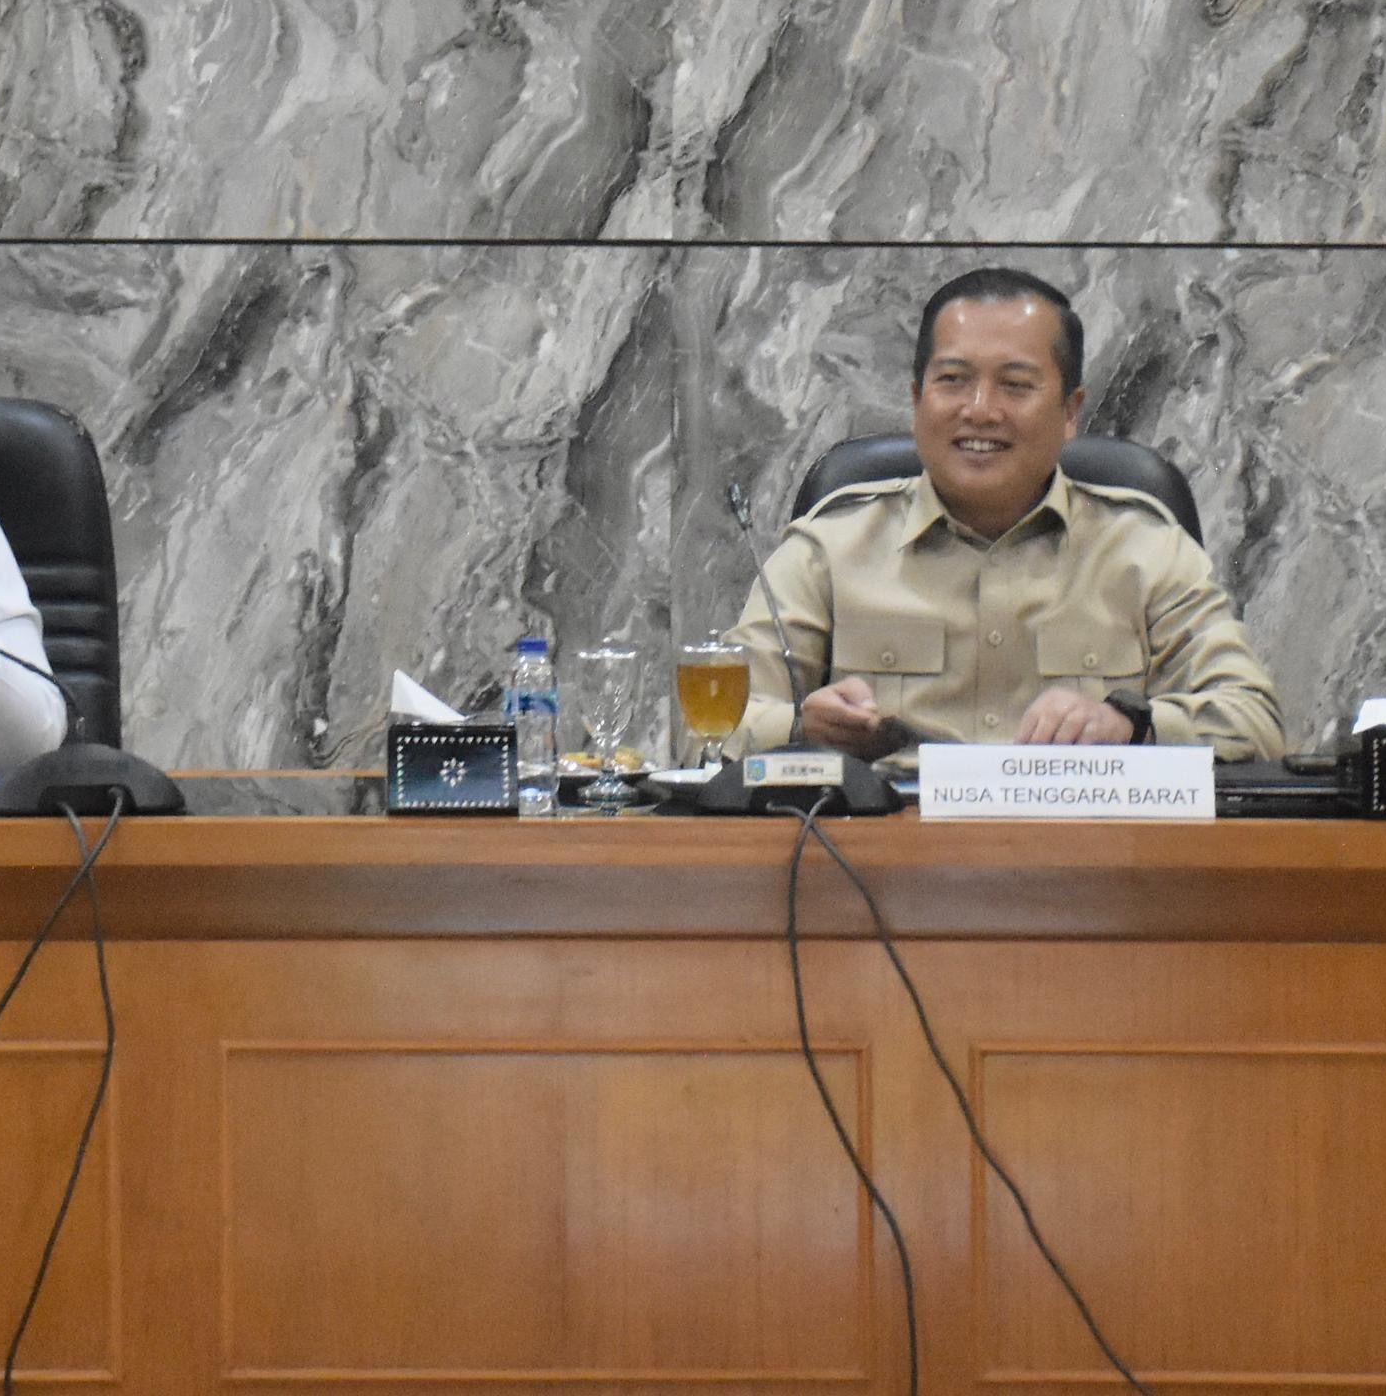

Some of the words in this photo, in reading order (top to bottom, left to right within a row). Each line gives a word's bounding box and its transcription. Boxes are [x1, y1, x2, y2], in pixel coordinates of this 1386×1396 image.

[1001, 758, 1126, 776] GUBERNUR
[933, 787, 993, 802] NUSA
[1000, 787, 1121, 804] TENGGARA
[1128, 788, 1199, 804] BARAT
